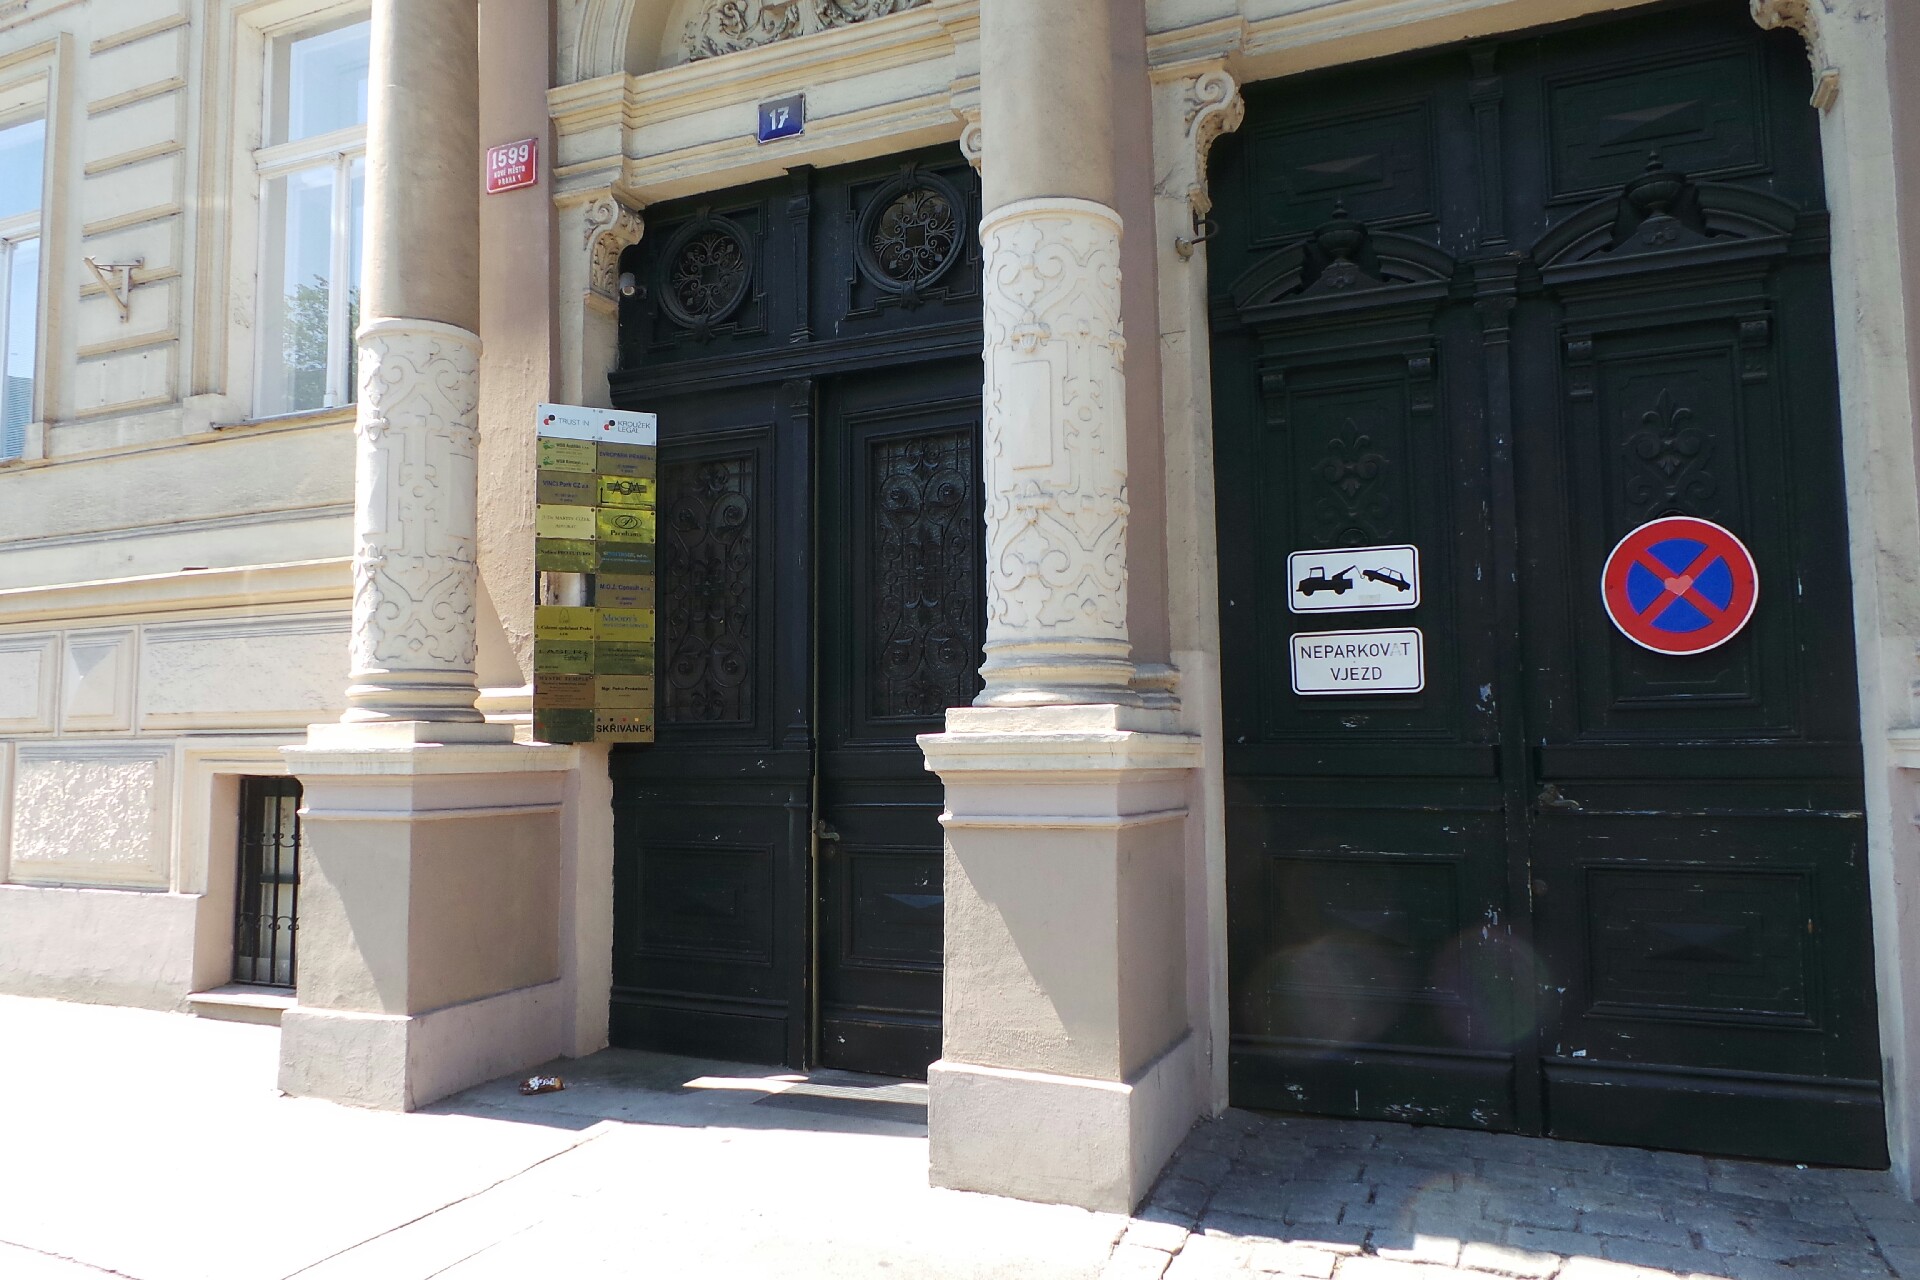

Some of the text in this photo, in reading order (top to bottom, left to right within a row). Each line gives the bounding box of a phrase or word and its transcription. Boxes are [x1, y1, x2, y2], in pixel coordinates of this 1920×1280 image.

[769, 106, 790, 131] 17
[492, 144, 529, 169] 1599
[558, 417, 581, 426] TRUST
[617, 420, 651, 429] KROUŽEK
[1300, 642, 1411, 659] NEPARKOVAT
[1330, 666, 1382, 681] VJEZD
